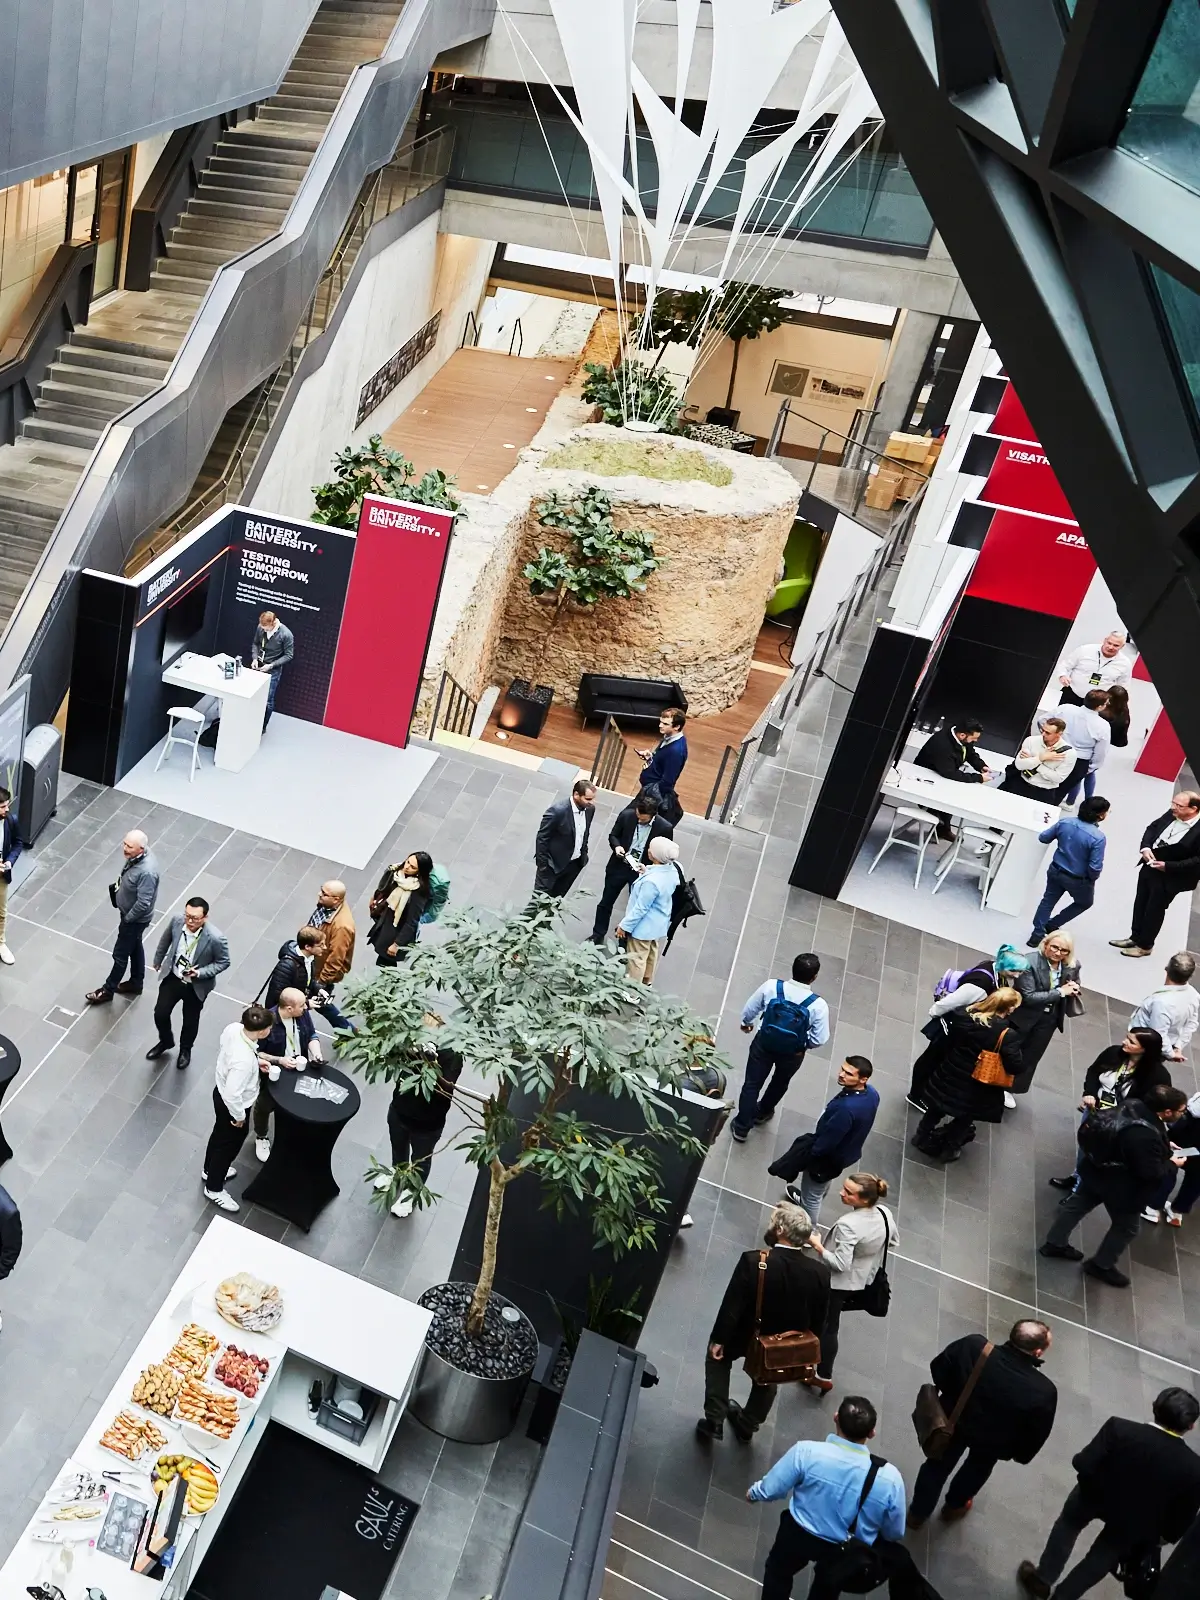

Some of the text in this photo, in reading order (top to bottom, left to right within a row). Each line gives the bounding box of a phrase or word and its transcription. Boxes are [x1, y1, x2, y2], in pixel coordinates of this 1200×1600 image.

[370, 506, 421, 524] BATTERY
[246, 519, 301, 540] BATTERY
[242, 549, 291, 569] TESTING
[240, 567, 277, 584] TODAY
[241, 558, 309, 585] TOMORROW,
[382, 1503, 409, 1551] CATERING
